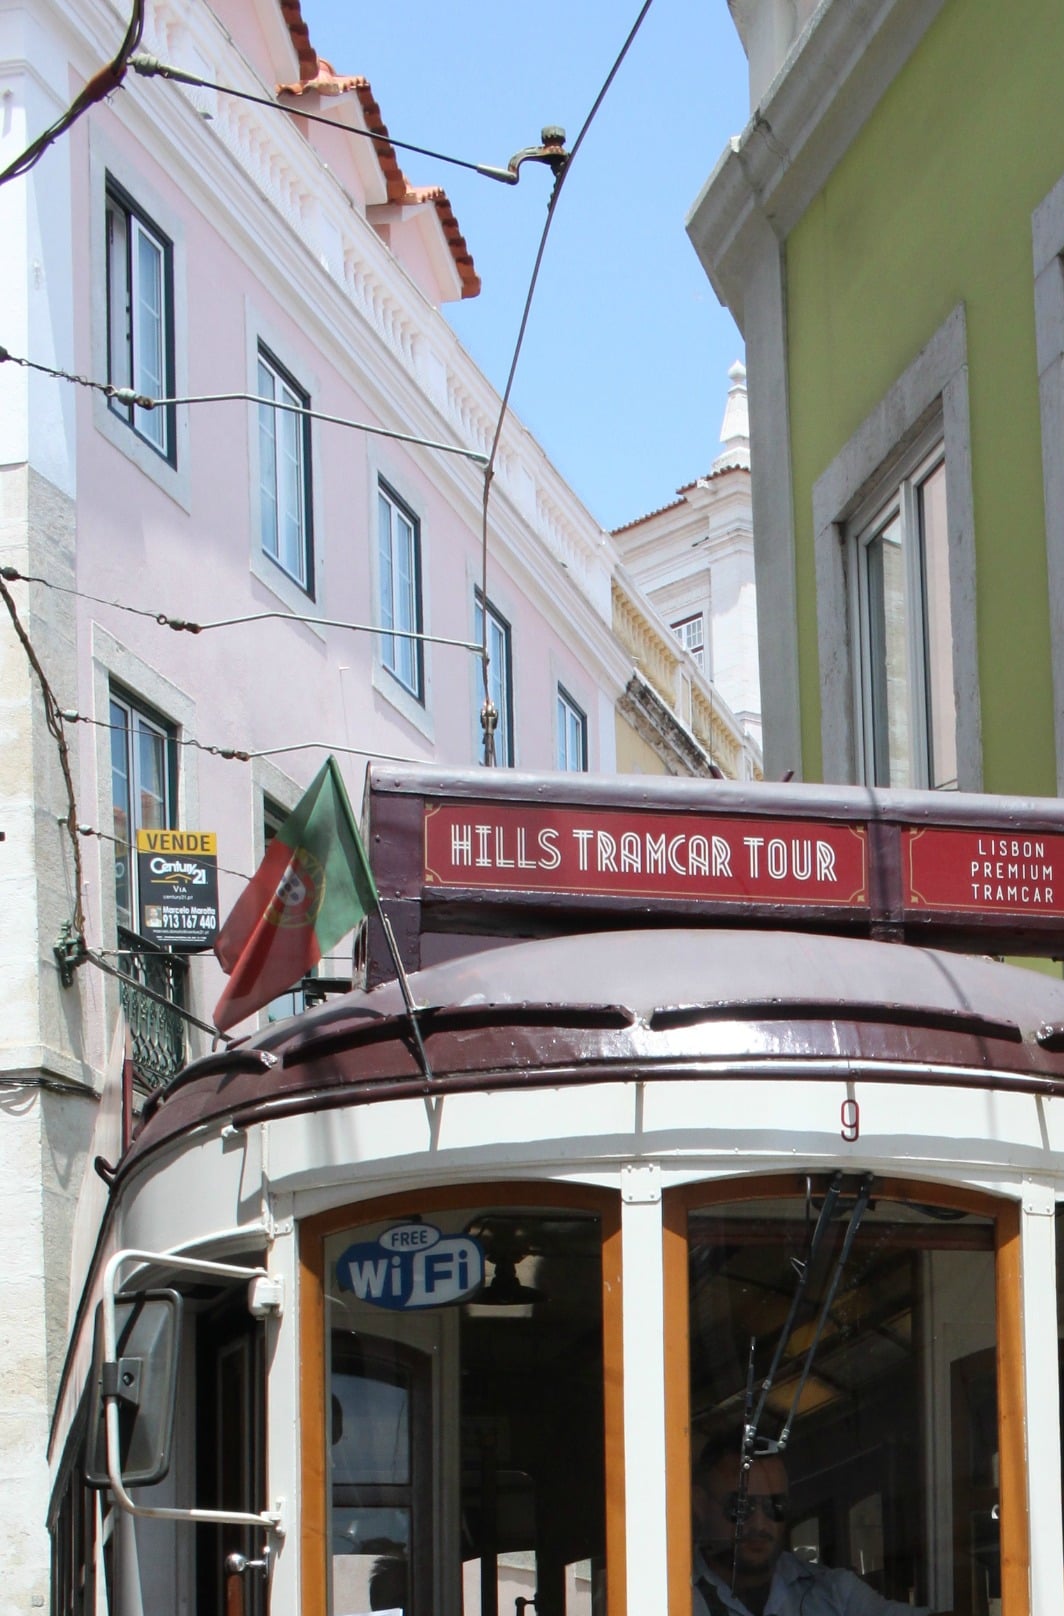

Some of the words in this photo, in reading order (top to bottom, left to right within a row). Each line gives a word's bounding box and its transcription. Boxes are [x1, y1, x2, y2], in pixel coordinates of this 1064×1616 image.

[146, 833, 211, 852] VENDE
[978, 839, 1044, 858] LISBON
[451, 824, 562, 870] HILLS
[572, 829, 733, 878] TRAMCAR
[743, 837, 838, 882] TOUR
[150, 857, 197, 875] Century
[192, 869, 207, 885] 21
[971, 861, 1053, 881] PREMIUM
[971, 883, 1054, 903] TRAMCAR
[162, 906, 189, 914] Marcelo
[162, 914, 179, 928] 913
[181, 915, 198, 928] 167
[199, 915, 216, 930] 440
[841, 1099, 859, 1142] 9
[391, 1230, 428, 1247] FREE
